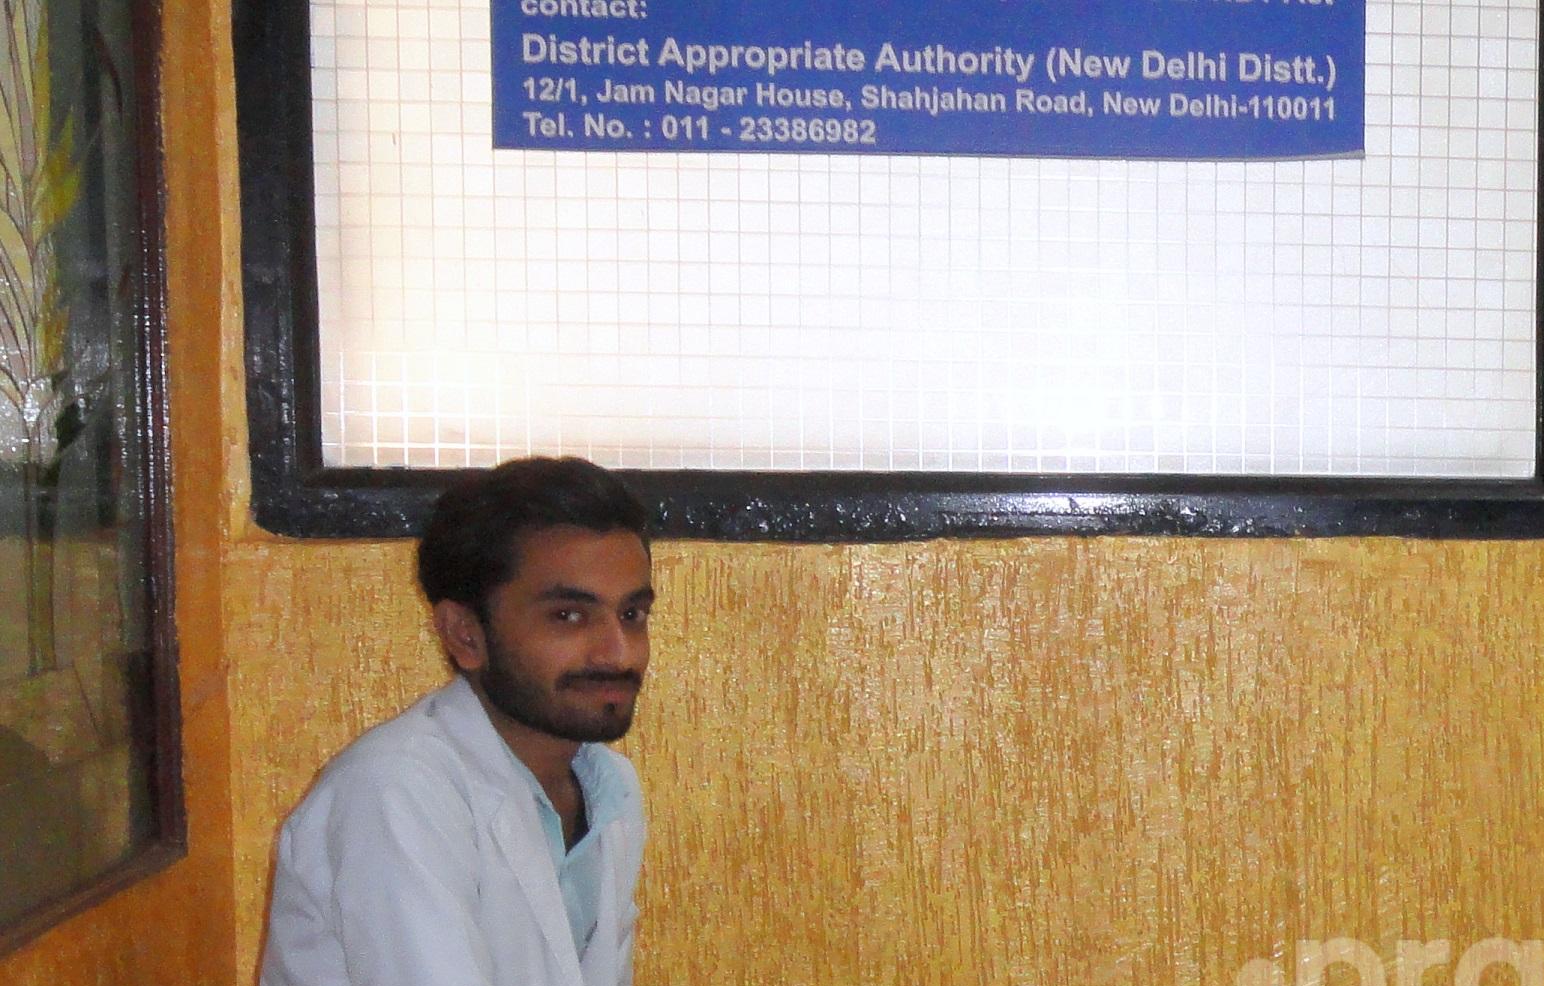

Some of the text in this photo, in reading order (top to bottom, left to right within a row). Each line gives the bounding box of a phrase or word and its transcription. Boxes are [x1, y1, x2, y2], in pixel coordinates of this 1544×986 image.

[521, 0, 647, 18] contact:
[522, 33, 1336, 91] District Appropriate Authority (New Delhi Distt.)
[523, 77, 1334, 120] 12/1, Jam Nagar House, Shahjahan Road, New Delhi-110011
[523, 112, 573, 137] Tel.
[584, 113, 632, 139] No.
[661, 115, 709, 141] 011
[739, 117, 876, 145] 23386982
